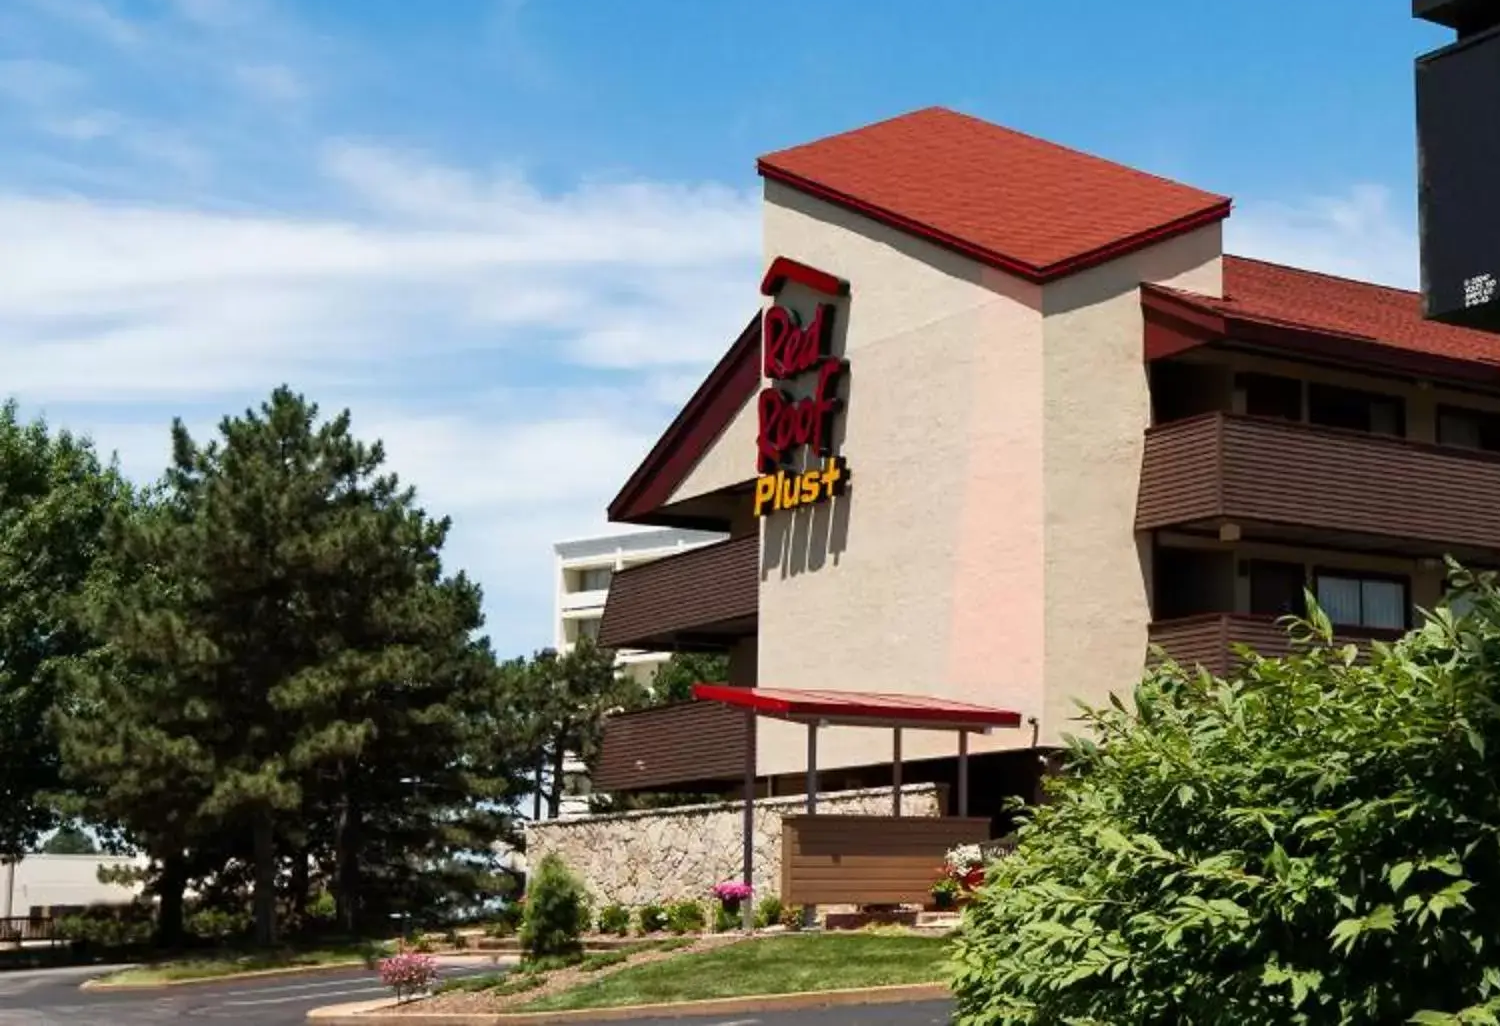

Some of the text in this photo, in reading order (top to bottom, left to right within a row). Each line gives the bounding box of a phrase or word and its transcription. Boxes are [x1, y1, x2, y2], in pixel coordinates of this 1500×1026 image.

[764, 303, 823, 379] Red
[757, 357, 840, 474] Roof
[754, 458, 841, 516] Plus+
